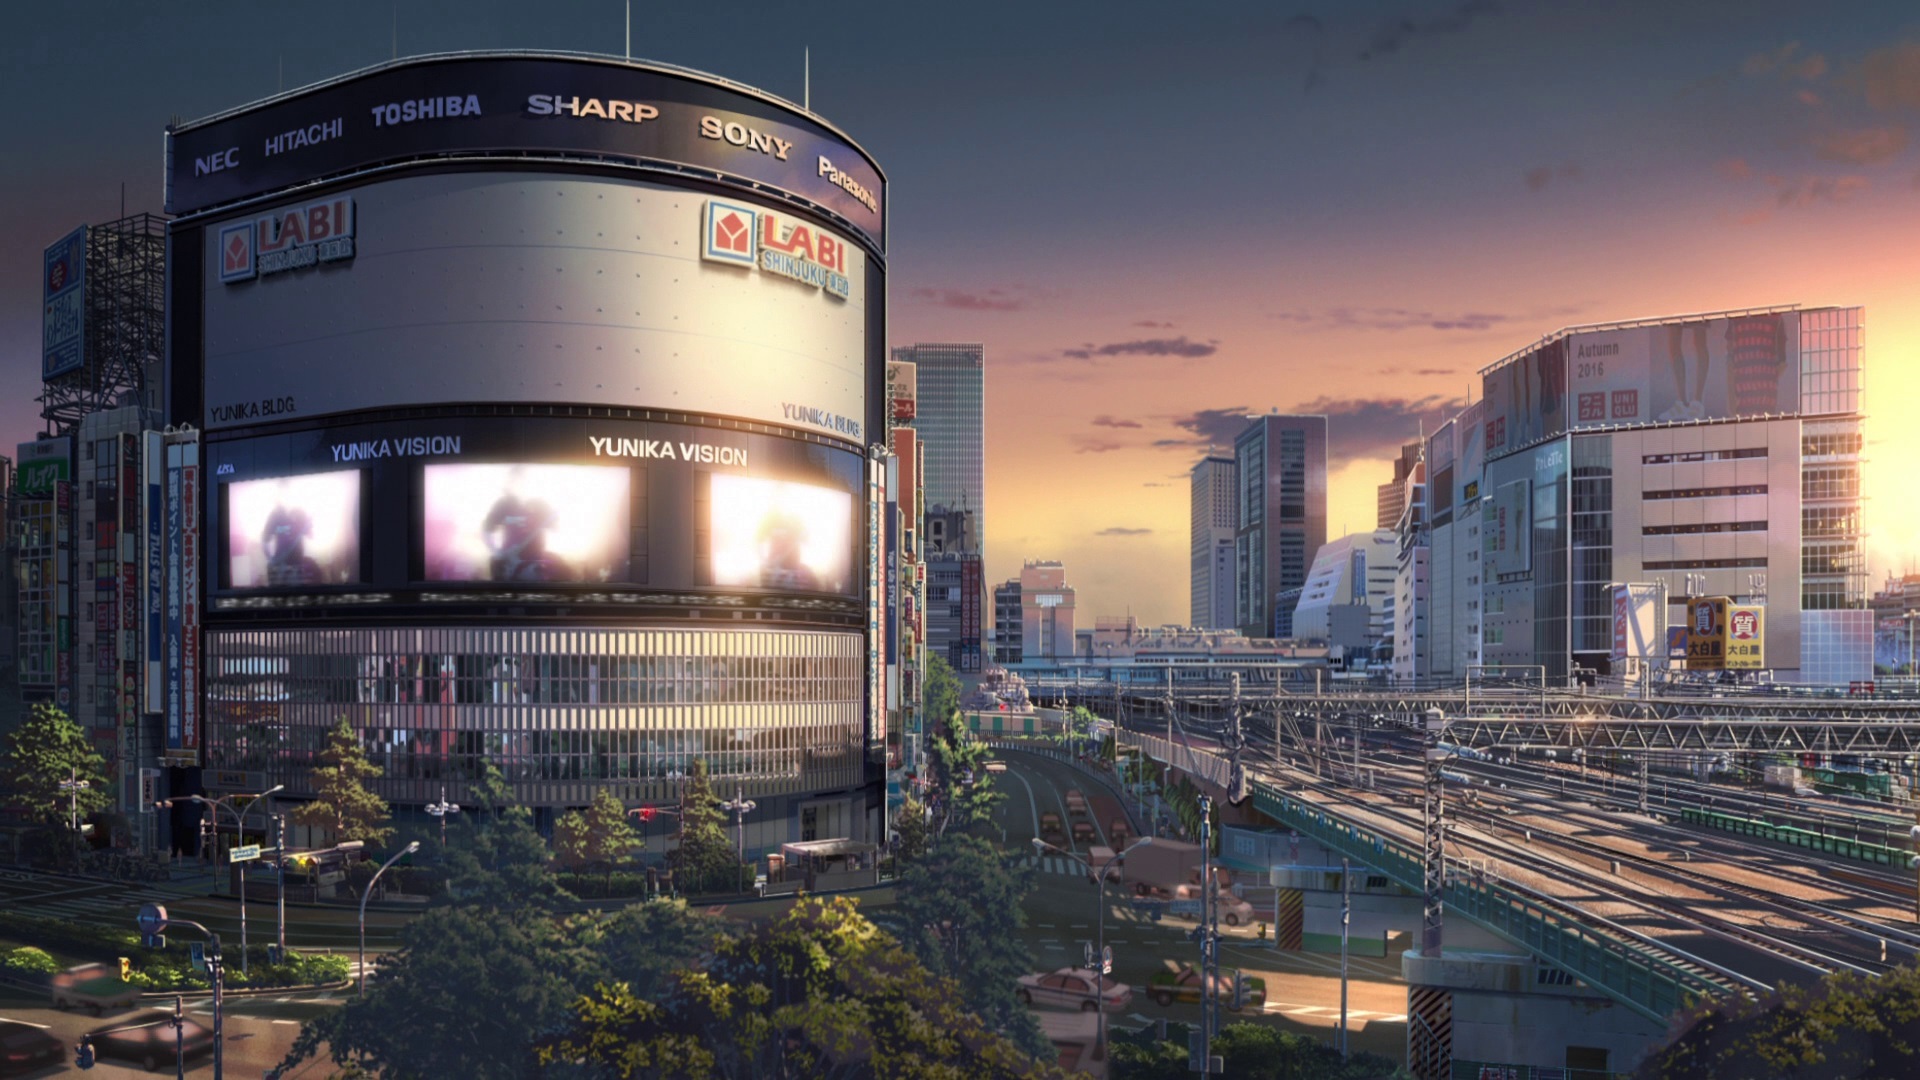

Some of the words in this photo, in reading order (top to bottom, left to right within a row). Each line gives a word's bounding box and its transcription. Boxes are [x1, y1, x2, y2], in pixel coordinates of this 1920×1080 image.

[372, 94, 482, 127] TOSHIBA
[527, 94, 660, 124] SHARP
[265, 117, 343, 157] HITACHI
[700, 115, 793, 161] SONY
[195, 147, 240, 177] NEC
[818, 155, 878, 215] Panasonic
[259, 201, 343, 252] LABI
[763, 214, 844, 273] LABI
[258, 245, 317, 273] SHINJUKU
[764, 251, 826, 287] SHINJUKU
[1577, 340, 1619, 360] Autumn
[1577, 361, 1604, 379] 2016
[211, 402, 260, 422] YUNIKA
[781, 402, 835, 430] YUNIKA
[331, 439, 391, 463] YUNIKA
[394, 435, 461, 456] VISION
[589, 435, 676, 460] YUNIKA
[679, 441, 748, 467] VISION
[150, 532, 161, 566] STYLE
[888, 585, 896, 607] STYLE
[1696, 606, 1711, 633] 質
[1733, 615, 1755, 637] 質
[1728, 645, 1760, 656] 大白屋
